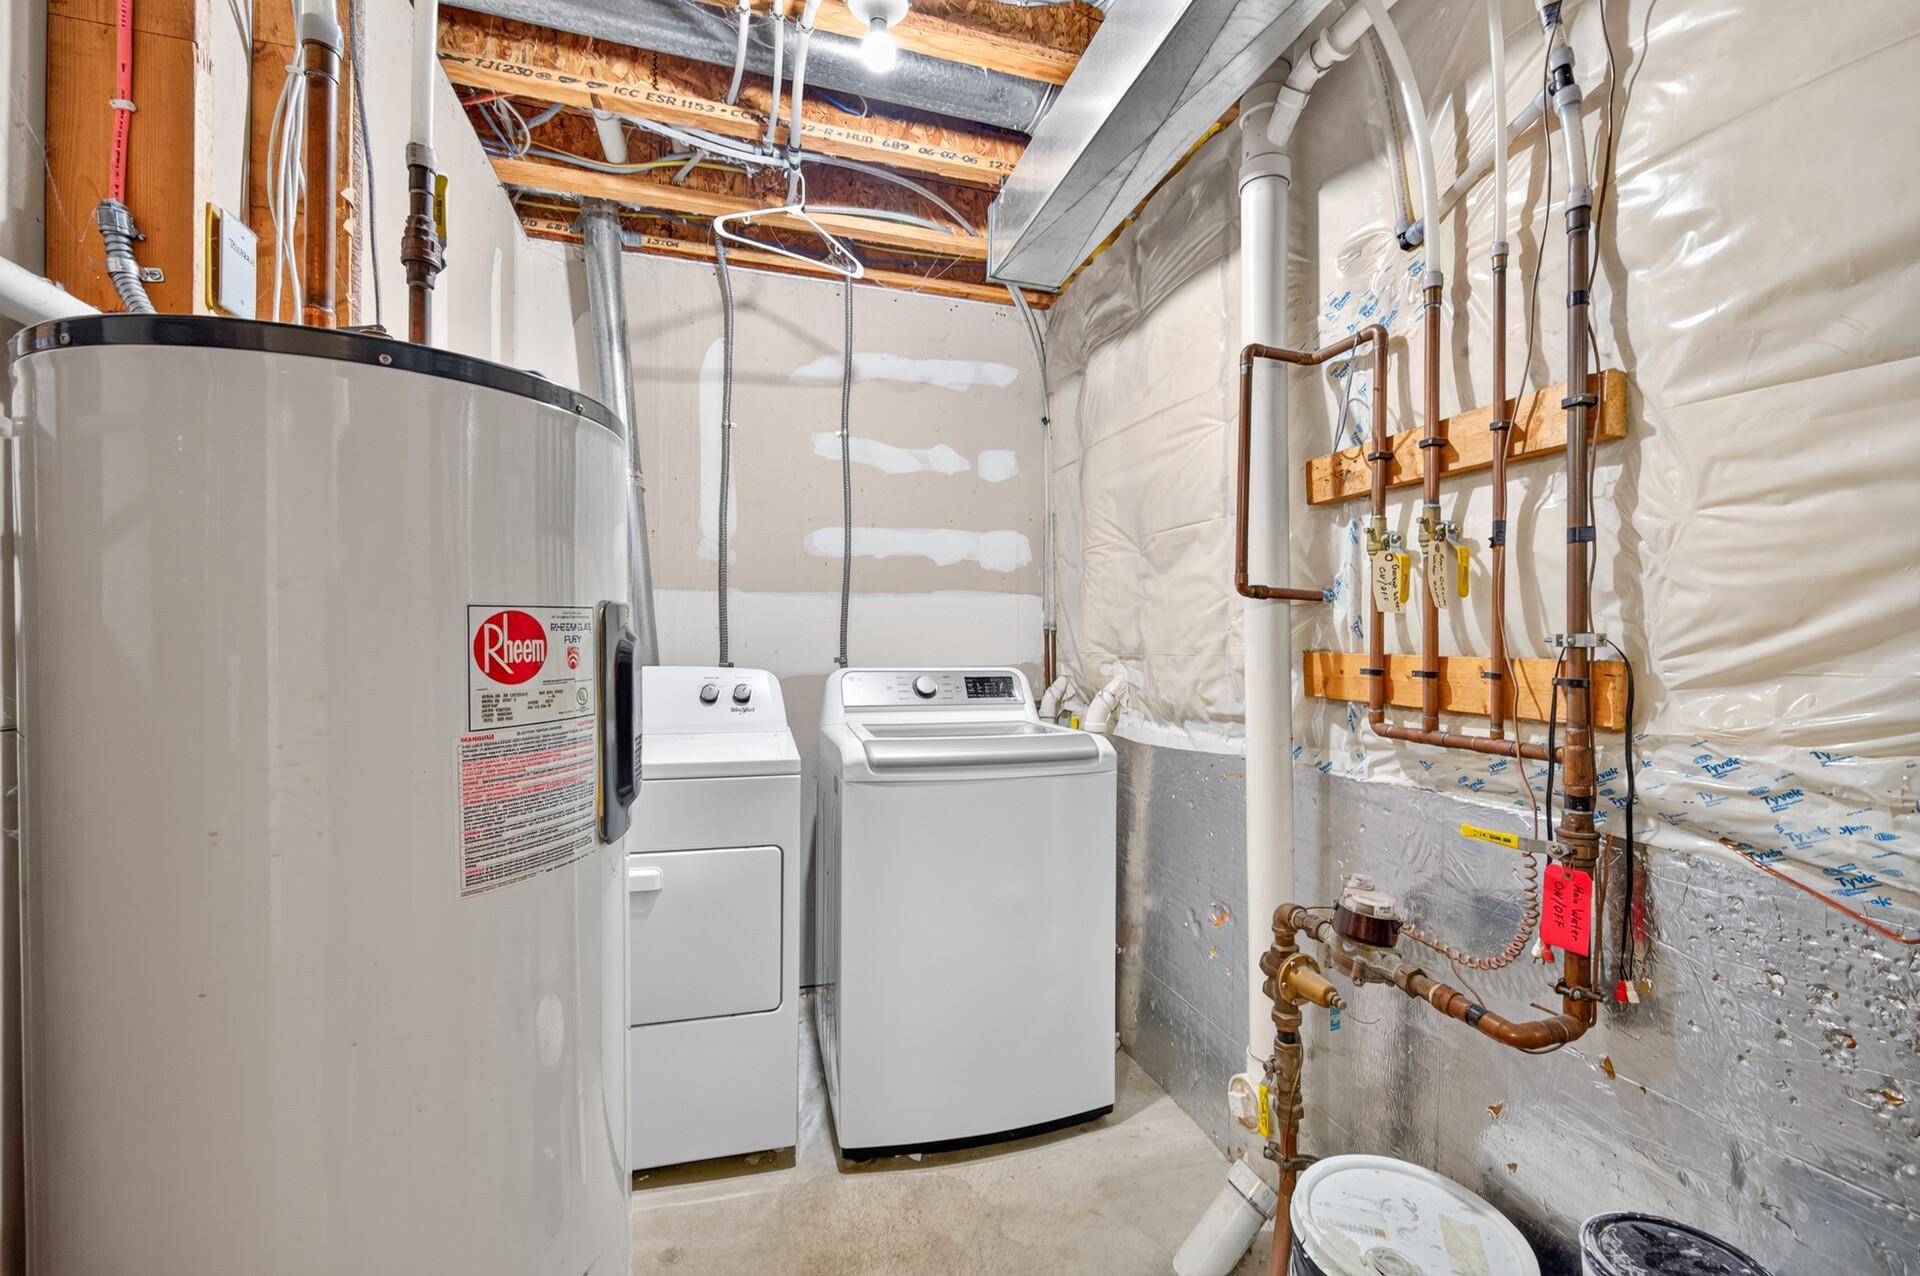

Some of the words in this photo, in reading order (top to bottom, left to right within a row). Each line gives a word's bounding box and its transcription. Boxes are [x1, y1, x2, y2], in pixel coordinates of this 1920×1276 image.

[613, 86, 640, 98] ICC
[645, 92, 677, 106] ESR
[846, 131, 873, 145] HUD
[882, 139, 909, 151] 689
[483, 613, 545, 675] Rheem
[1701, 757, 1741, 774] Tyvek
[1760, 788, 1804, 806] Tyvek
[1553, 880, 1567, 929] ON/OFF
[1571, 909, 1584, 942] Water
